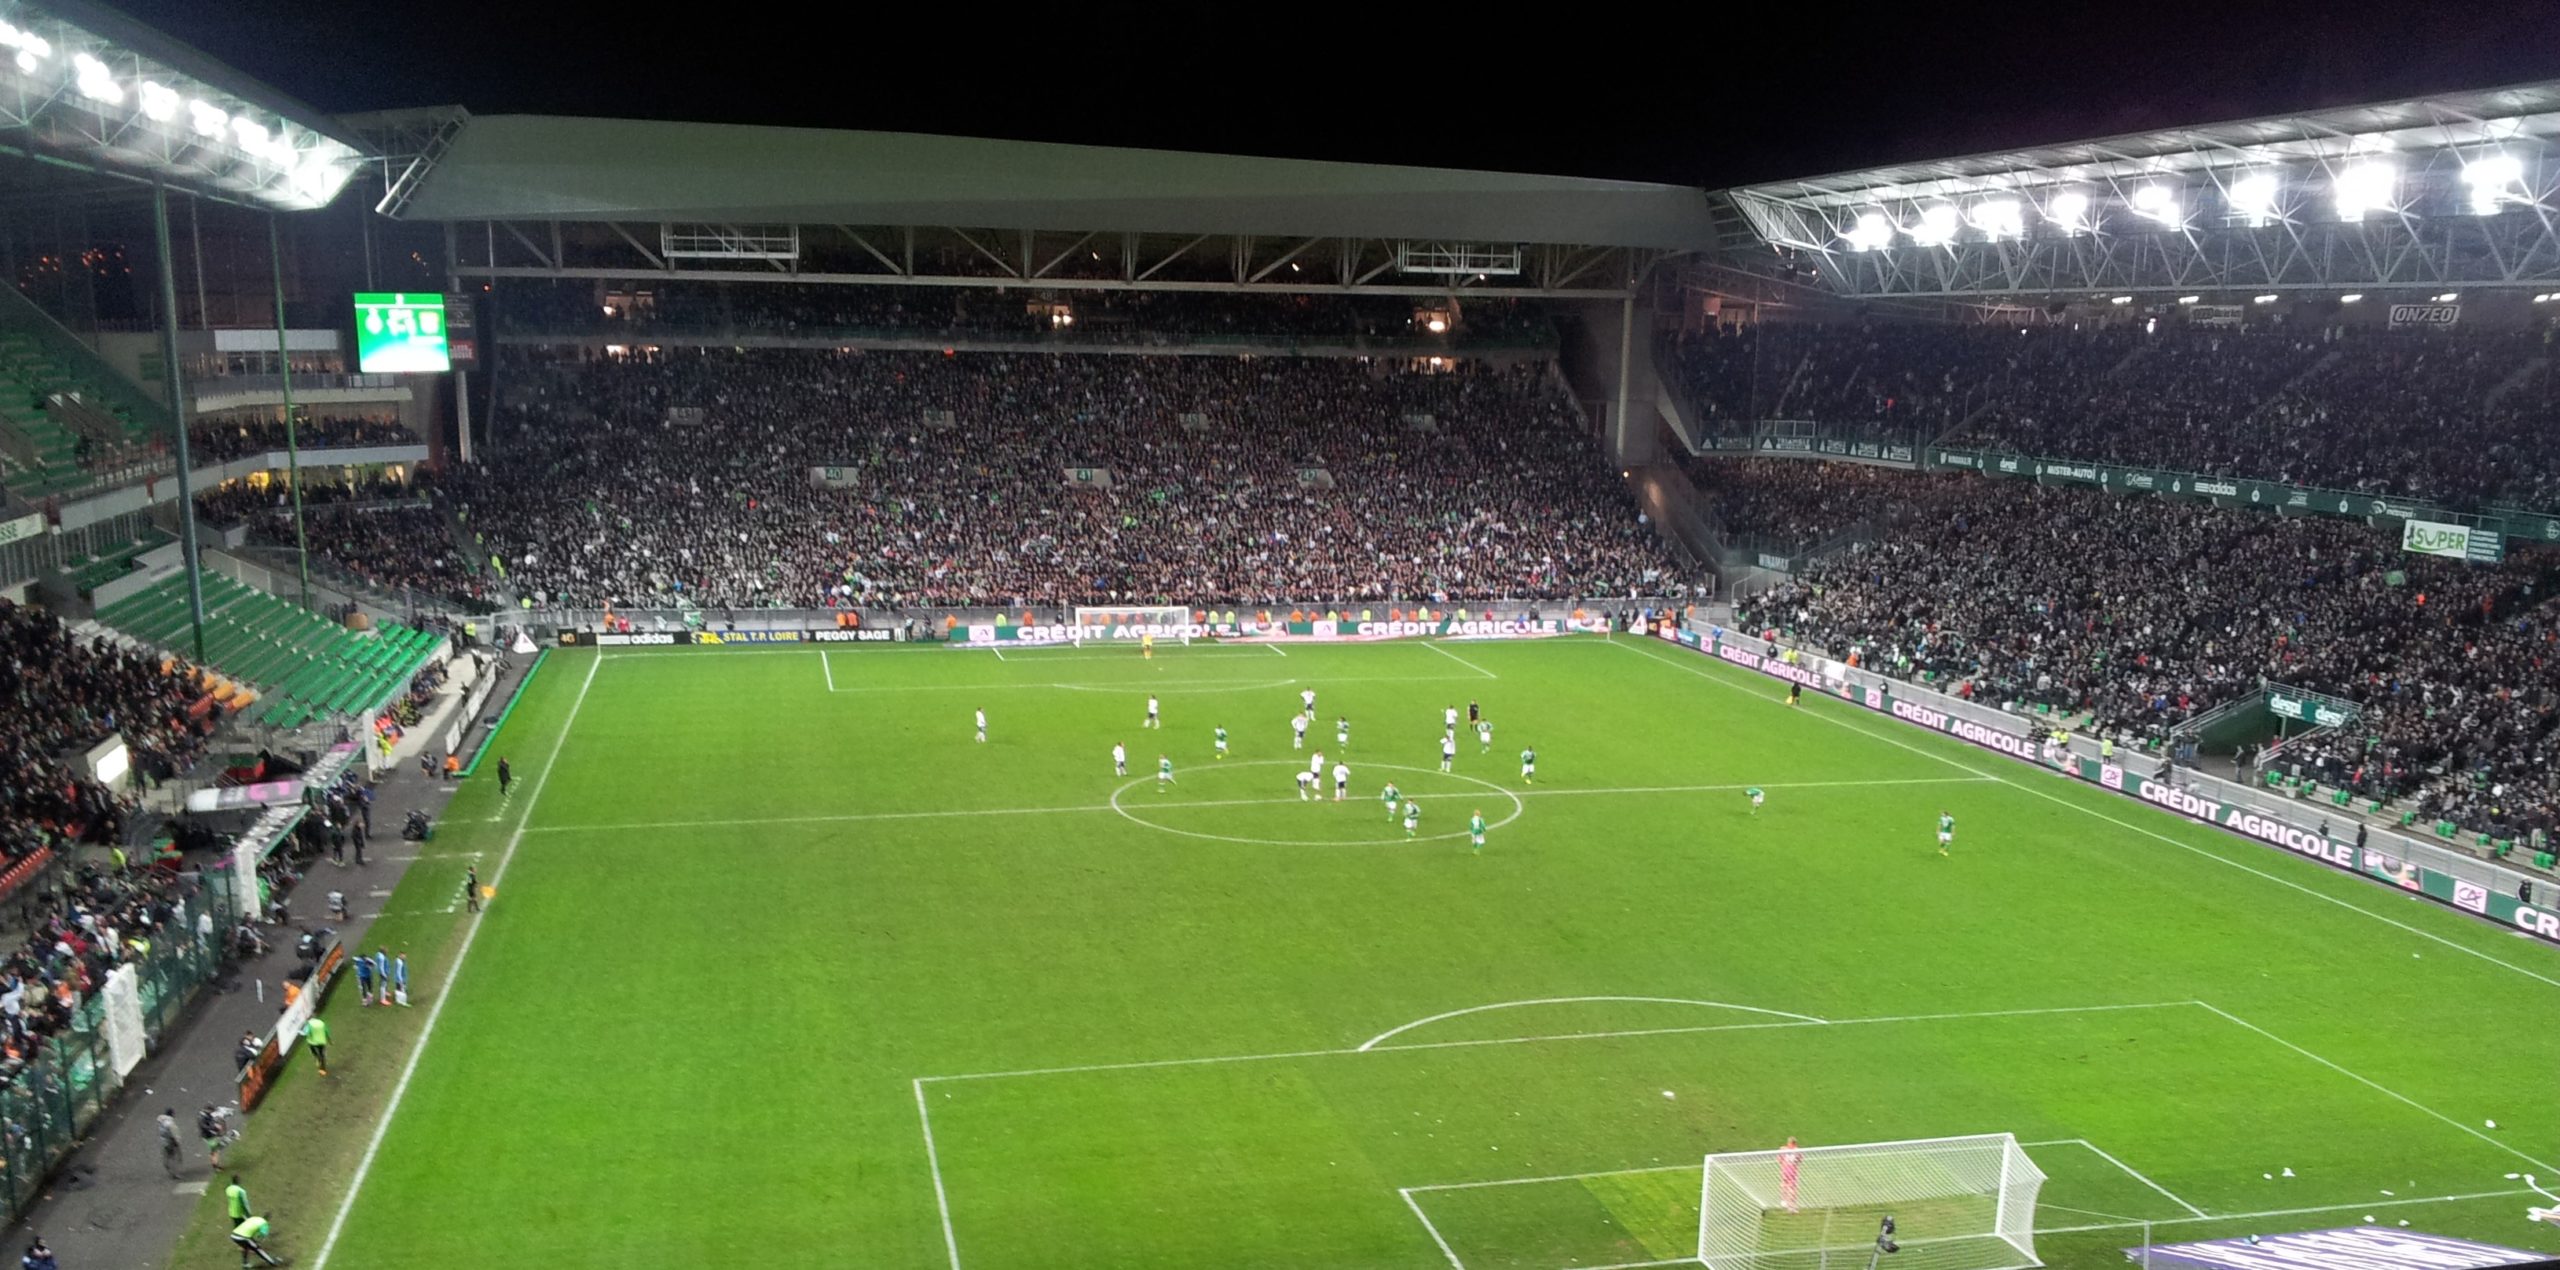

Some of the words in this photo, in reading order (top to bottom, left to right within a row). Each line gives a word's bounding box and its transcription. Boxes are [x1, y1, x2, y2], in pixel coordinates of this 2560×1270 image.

[2394, 306, 2452, 323] ONZEO
[2047, 464, 2094, 480] MISTER-AUTO
[2208, 481, 2237, 496] adidas
[2415, 528, 2466, 551] SUPER
[816, 631, 856, 641] PEGGY
[857, 630, 890, 640] SAGE
[1357, 620, 1440, 635] CRÉDIT
[1446, 620, 1558, 635] AGRICOLE
[630, 633, 674, 645] adidas
[768, 631, 799, 641] LOIRE
[1720, 644, 1760, 668] CRÉDIT
[1761, 659, 1821, 689] AGRICOLE
[1892, 700, 1949, 729] CRÉDIT
[1950, 719, 2037, 760] AGRICOLE
[2139, 779, 2222, 822] CRÉDIT
[2225, 810, 2354, 867] AGRICOLE
